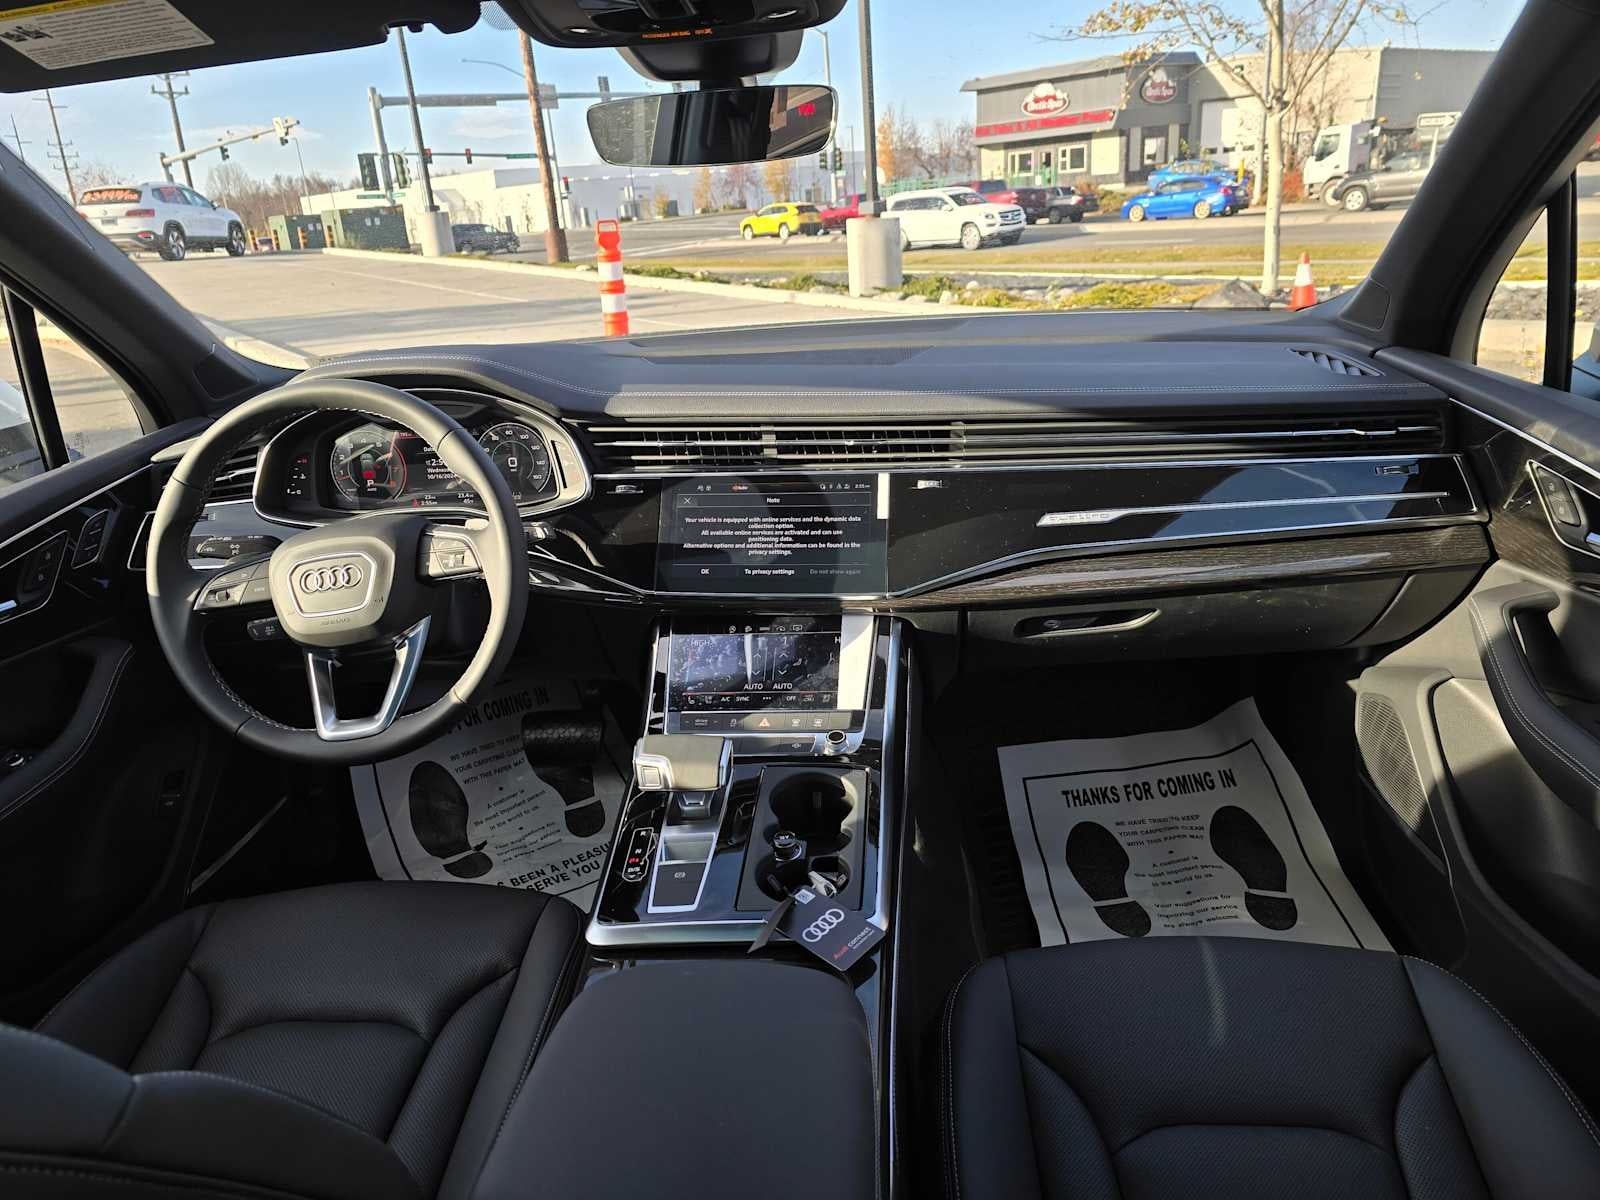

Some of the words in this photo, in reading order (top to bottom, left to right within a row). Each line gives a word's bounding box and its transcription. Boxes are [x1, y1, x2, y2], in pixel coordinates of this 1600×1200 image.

[507, 456, 518, 468] 0
[367, 479, 375, 487] P
[722, 516, 748, 524] equipped
[824, 516, 847, 524] dynamic
[752, 568, 771, 576] privacy
[772, 567, 795, 576] settings
[743, 682, 764, 690] AUTO
[773, 682, 793, 690] AUTO
[484, 691, 532, 720] COMING
[534, 687, 550, 704] IN
[1061, 785, 1121, 808] THANKS
[1122, 780, 1155, 803] FOR
[1156, 770, 1217, 799] COMING
[1217, 768, 1238, 788] IN
[1126, 839, 1145, 847] WITH
[573, 859, 601, 877] YOU
[509, 868, 547, 887] BEEN
[550, 863, 561, 874] A
